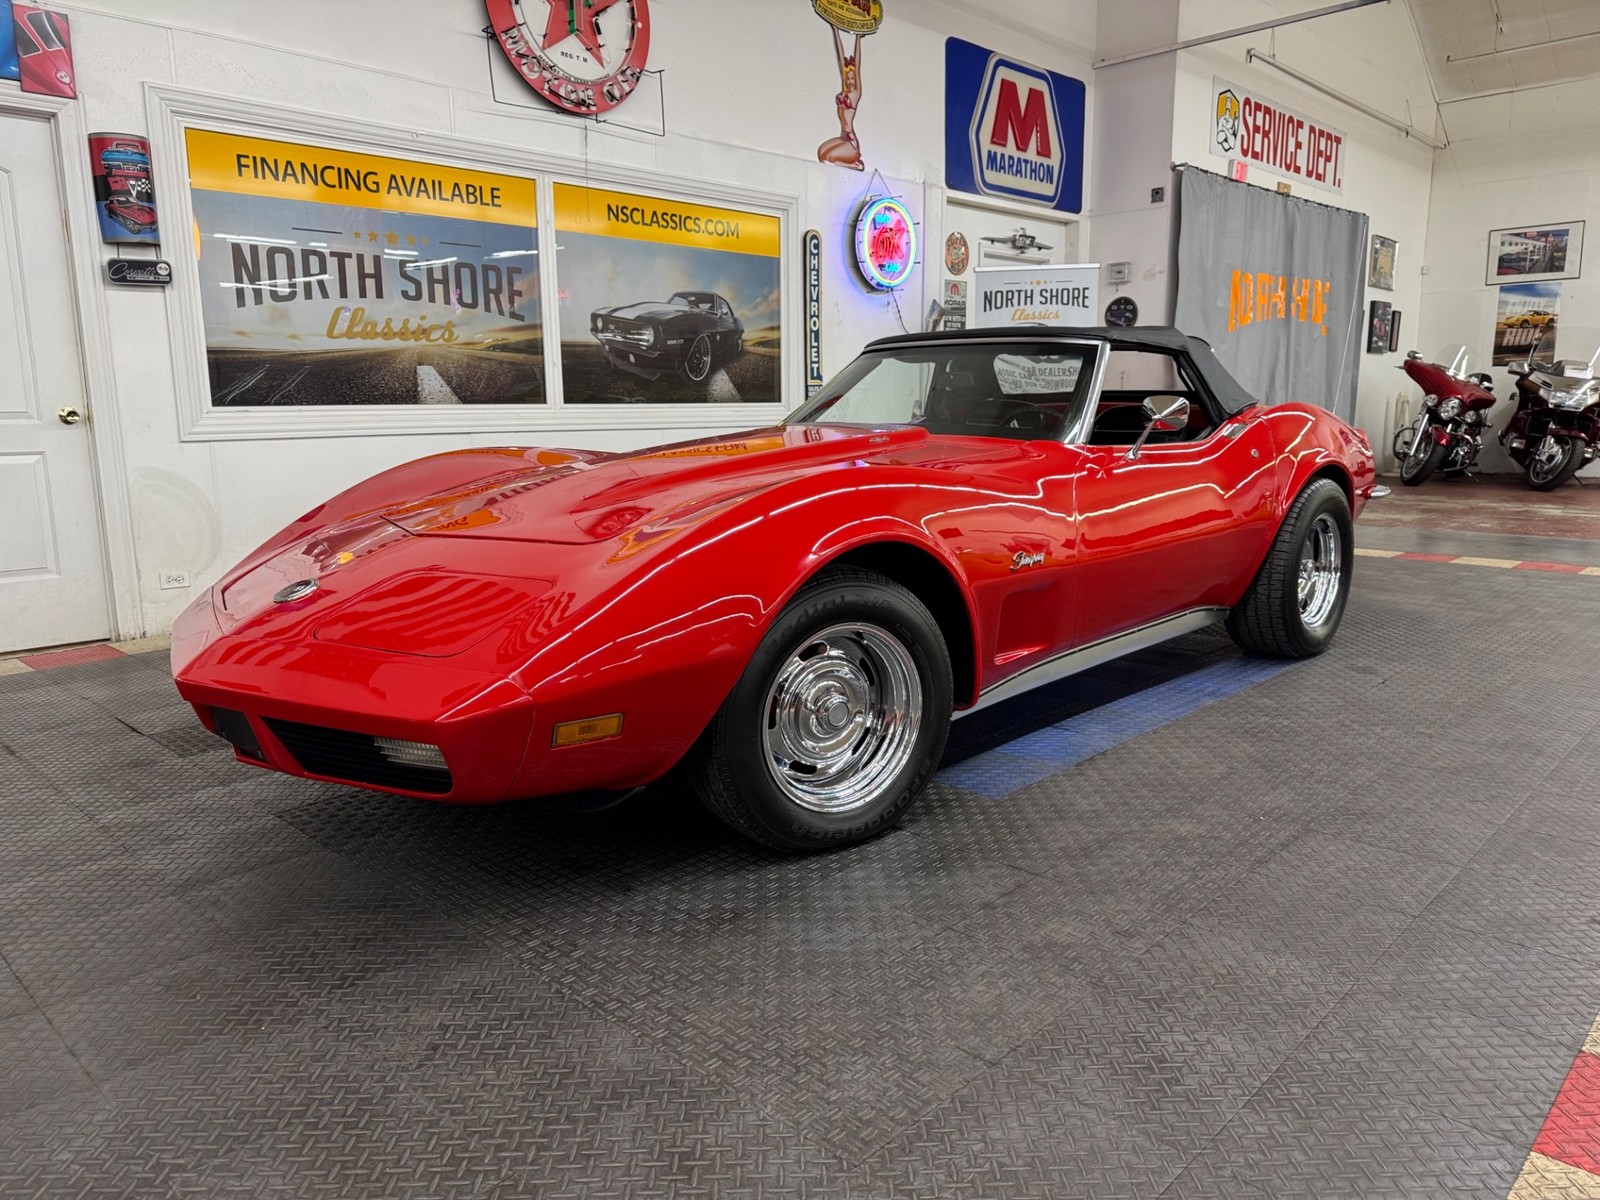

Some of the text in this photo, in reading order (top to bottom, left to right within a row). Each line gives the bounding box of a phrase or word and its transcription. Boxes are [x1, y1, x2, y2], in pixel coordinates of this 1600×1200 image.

[1240, 96, 1342, 188] SERVICE DEPT.
[235, 153, 503, 209] FINANCING AVAILABLE
[986, 149, 1055, 185] MARATHON
[606, 202, 740, 240] NSCLASSICS.COM
[109, 261, 157, 279] Corvette
[231, 242, 526, 324] NORTH SHORE
[810, 239, 819, 377] CHEVROLET
[983, 287, 1091, 313] NORTH SHORE
[1010, 308, 1063, 322] Classics
[325, 305, 460, 344] Classics
